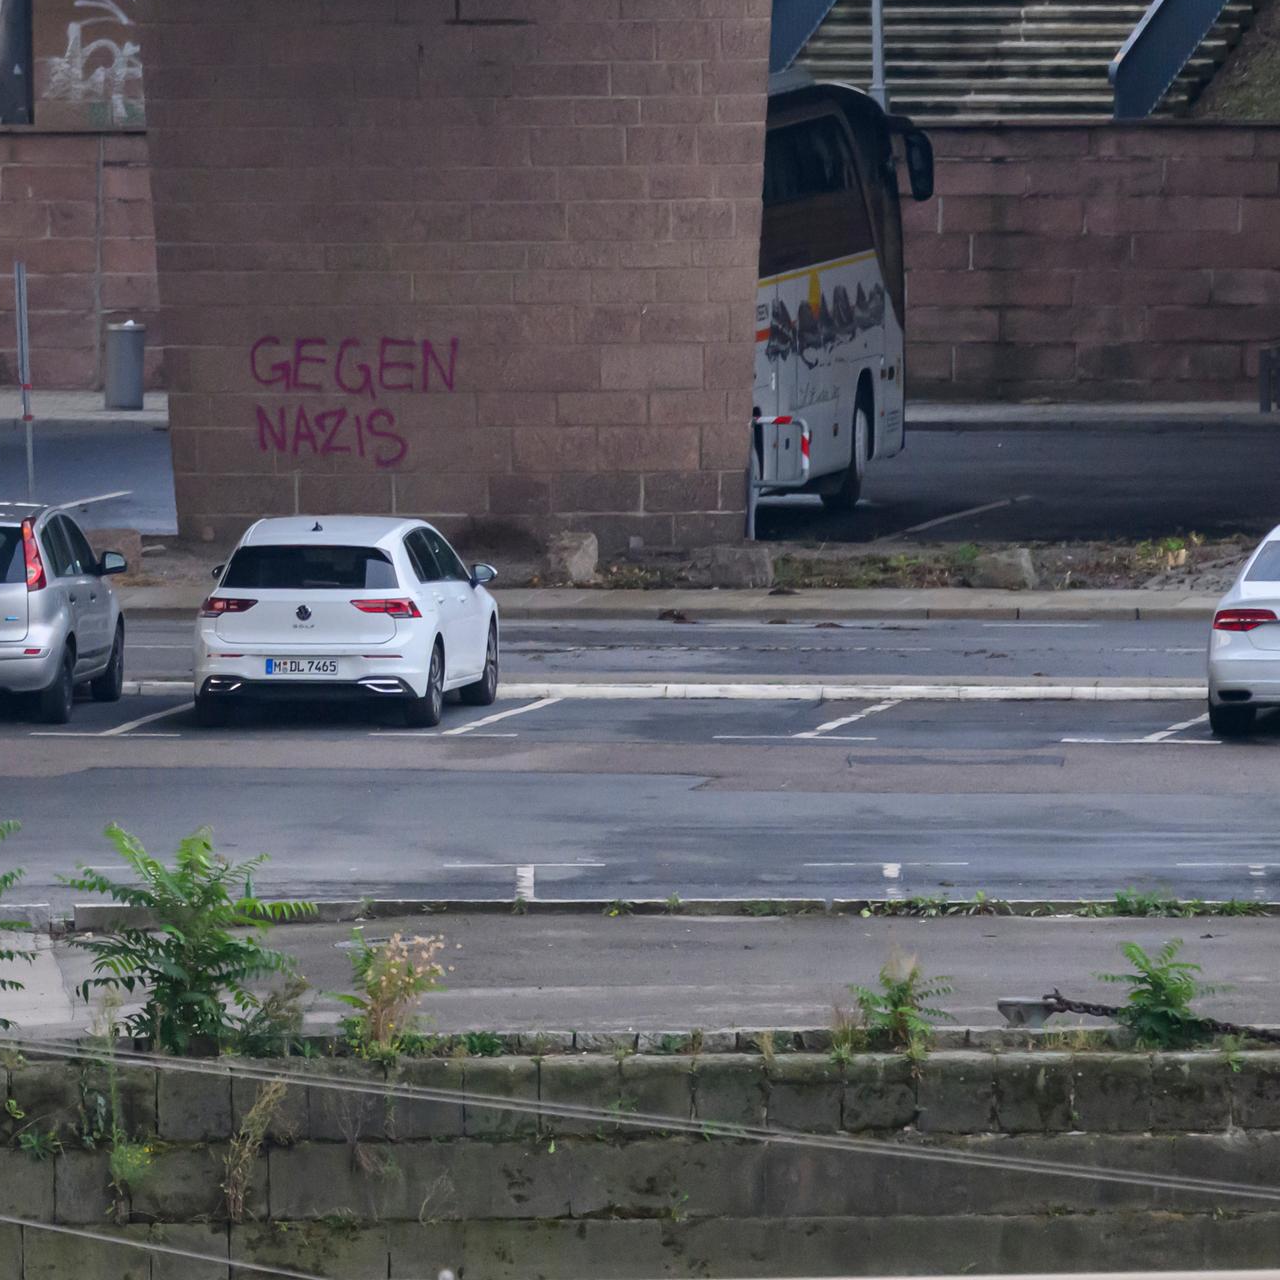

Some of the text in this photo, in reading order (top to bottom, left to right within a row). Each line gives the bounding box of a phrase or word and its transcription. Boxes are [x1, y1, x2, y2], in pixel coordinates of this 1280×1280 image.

[250, 335, 459, 400] GEGEN
[256, 404, 409, 469] NAZIS
[274, 661, 282, 672] M
